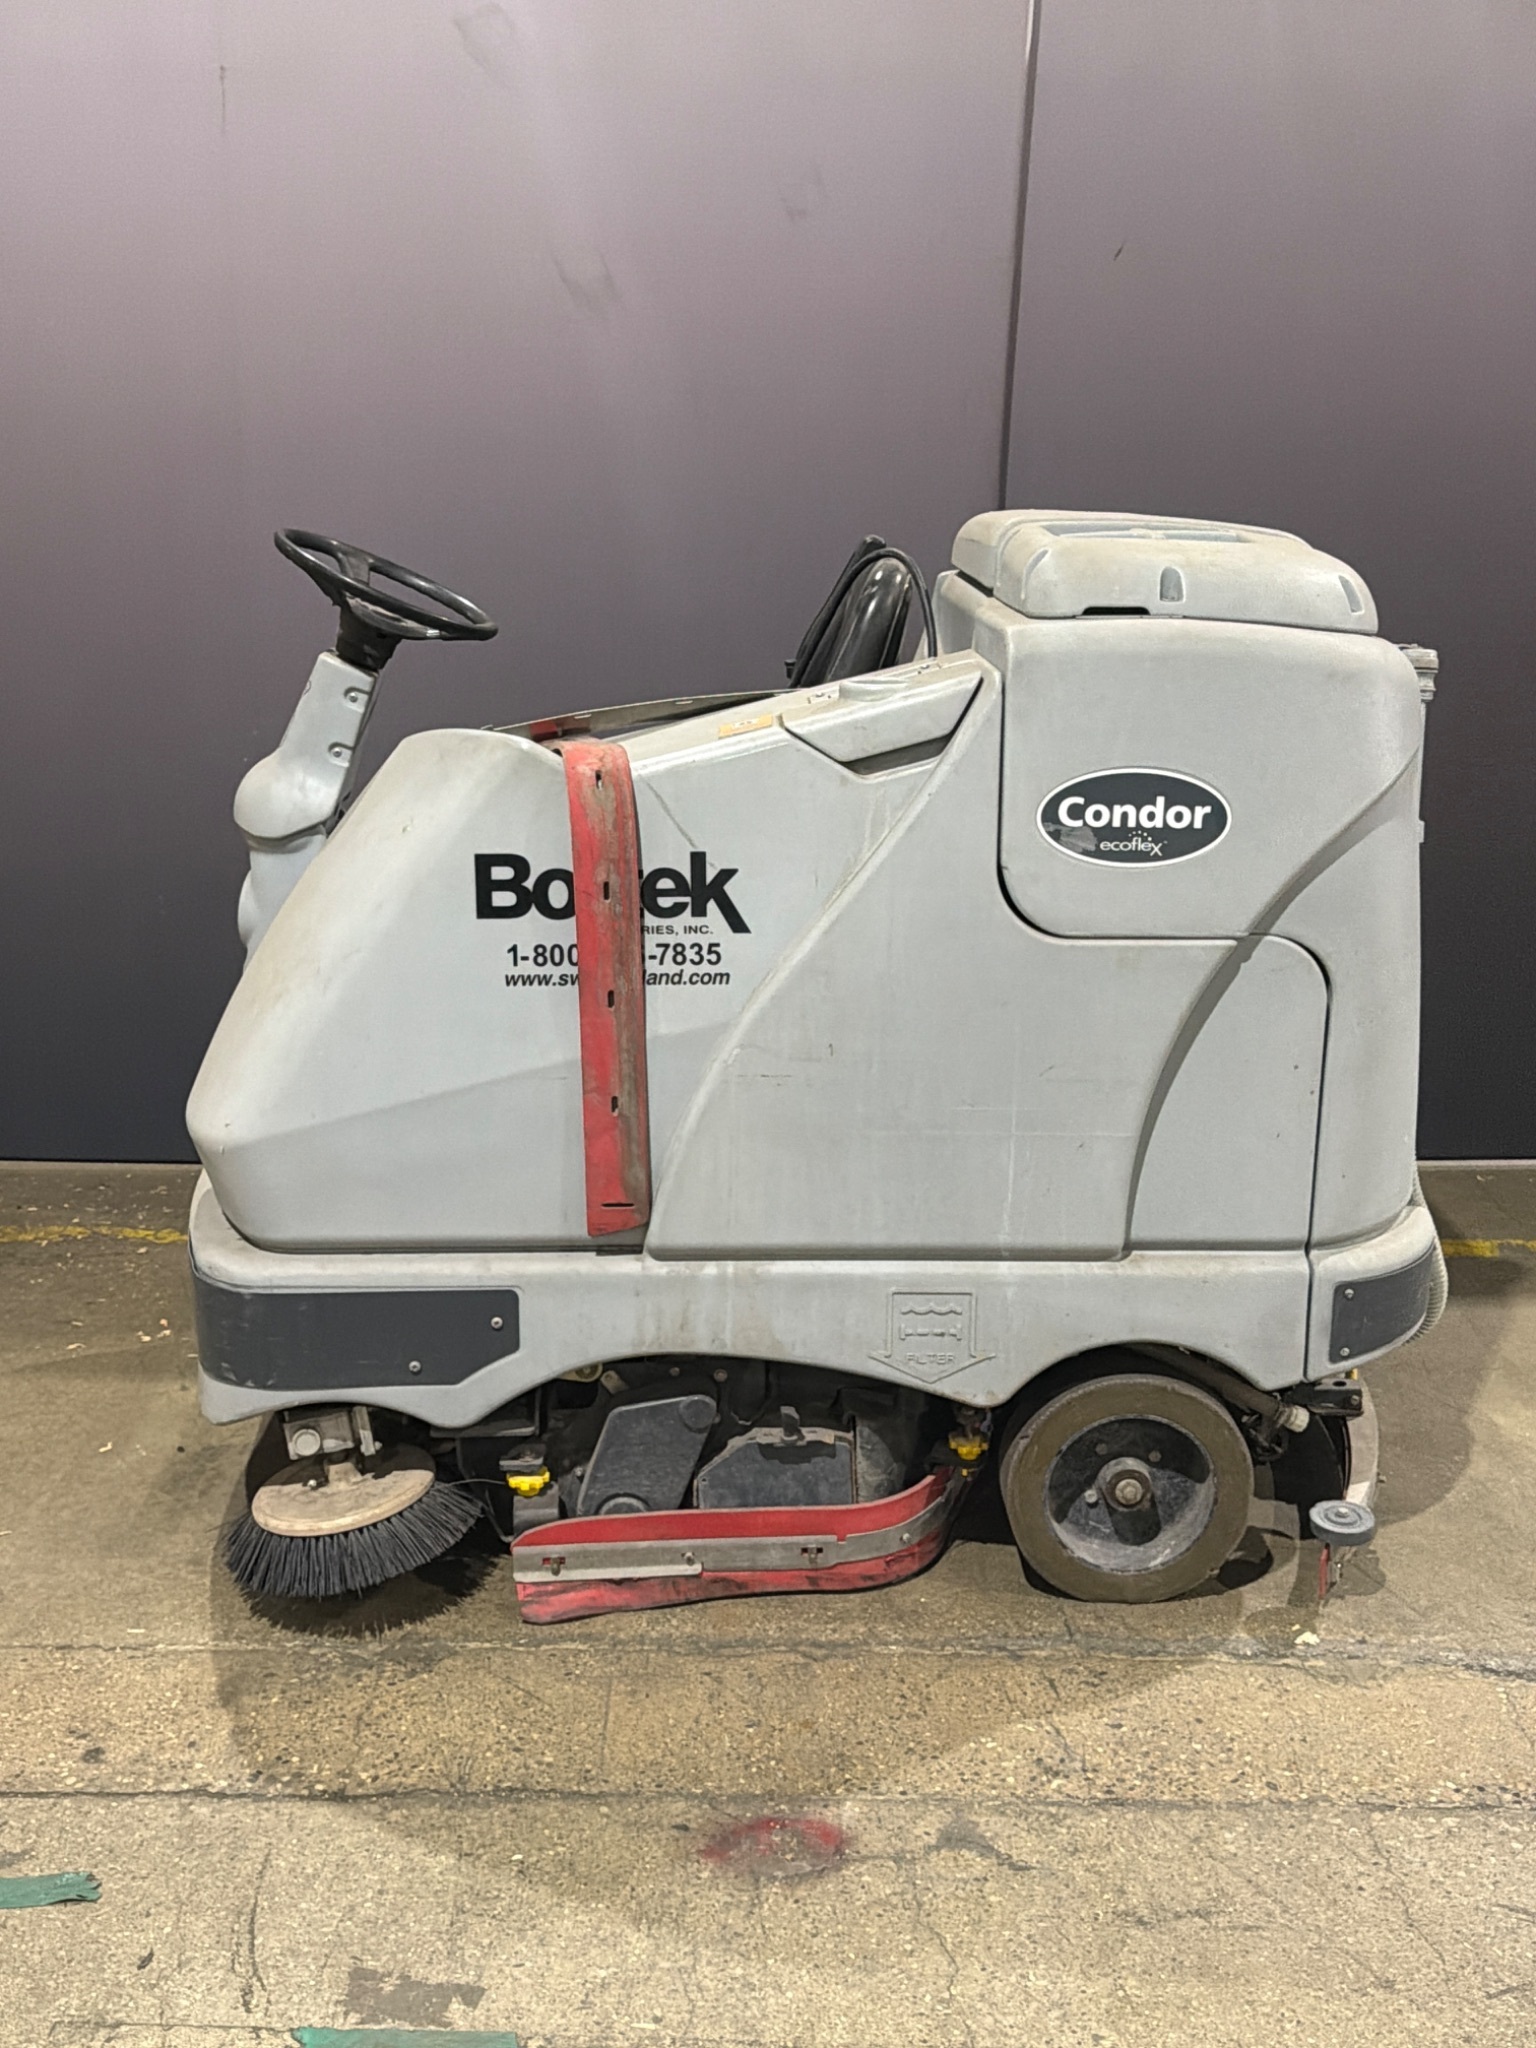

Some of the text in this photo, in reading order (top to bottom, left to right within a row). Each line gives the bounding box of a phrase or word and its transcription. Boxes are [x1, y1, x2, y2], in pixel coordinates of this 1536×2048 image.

[1057, 796, 1212, 829] Condor
[474, 851, 752, 934] Boek
[683, 924, 714, 935] INC.
[506, 943, 722, 967] 1-800-7835
[504, 969, 731, 987] www.swland.com
